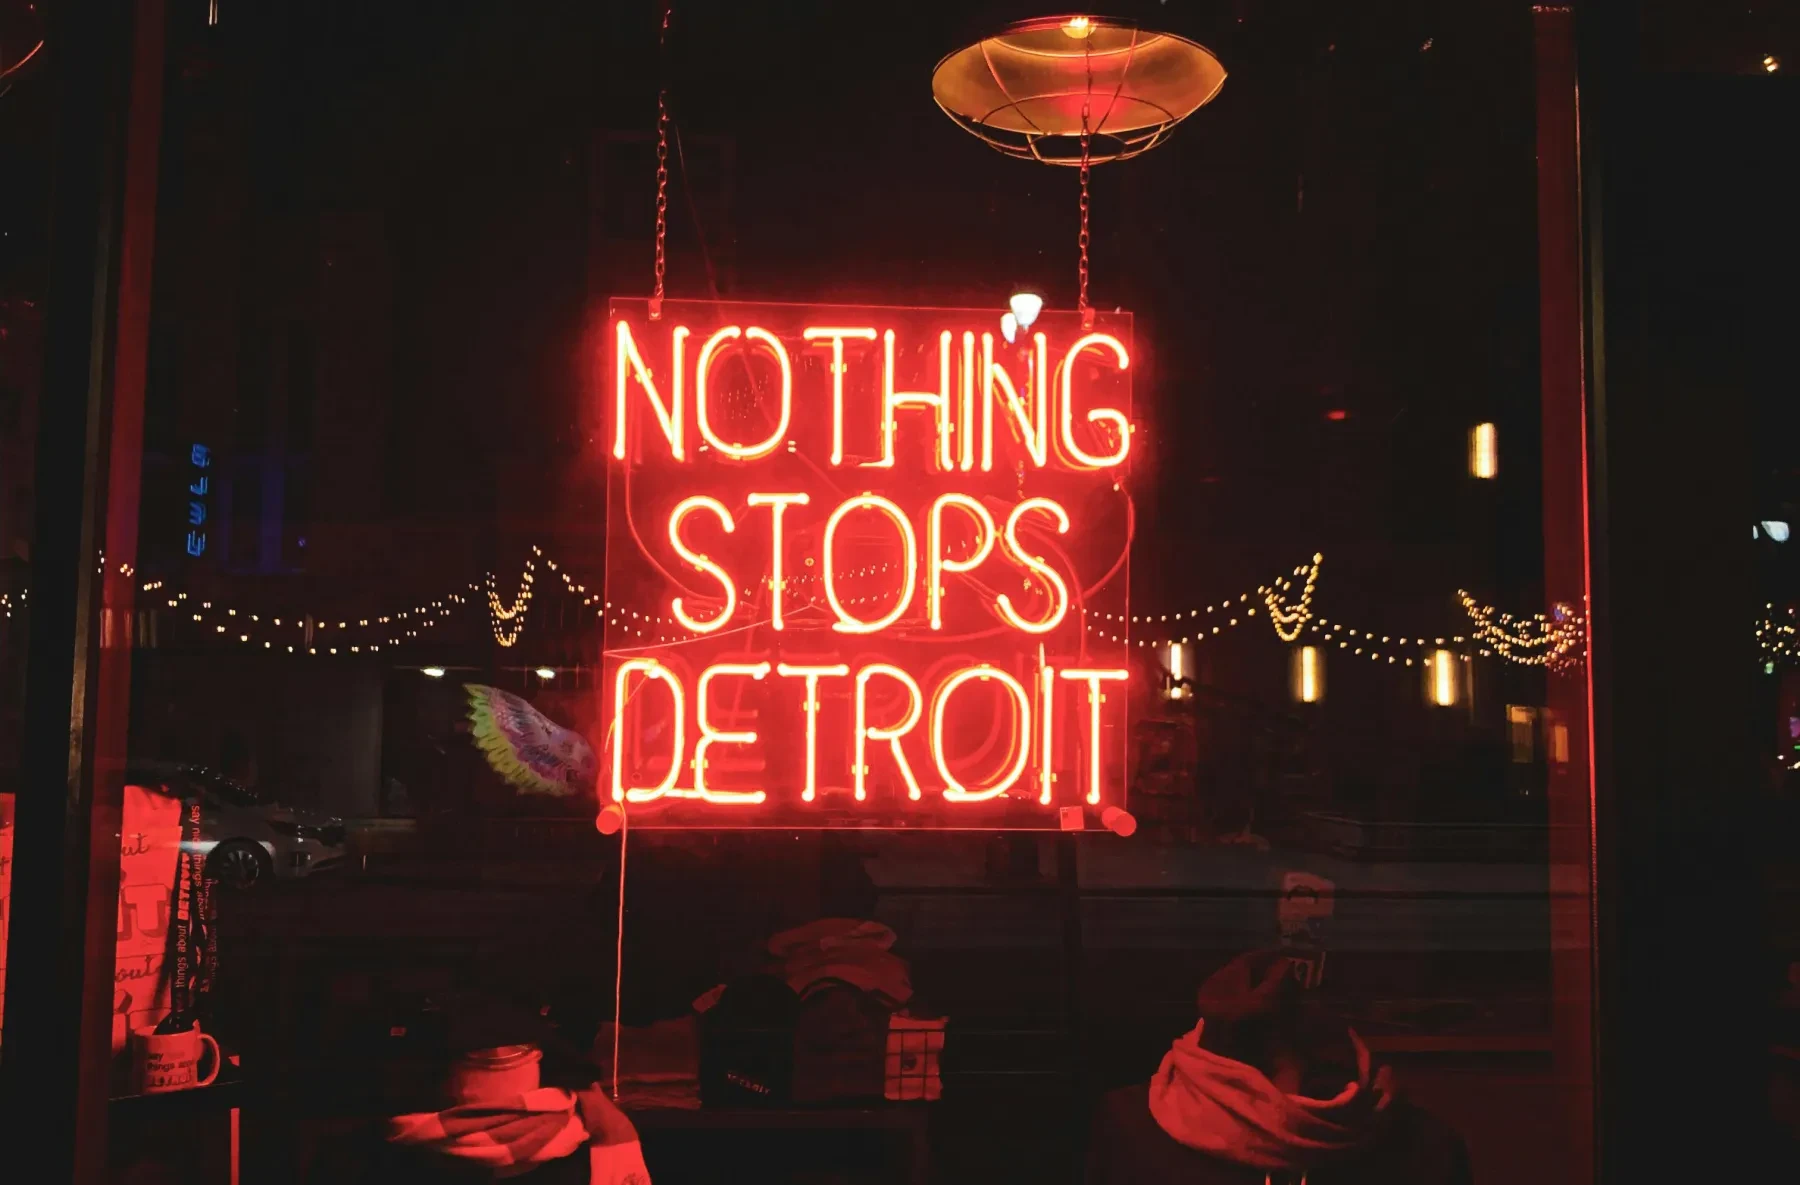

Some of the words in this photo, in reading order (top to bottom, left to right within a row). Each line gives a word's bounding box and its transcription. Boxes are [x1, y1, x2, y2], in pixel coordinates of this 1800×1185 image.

[613, 319, 1131, 471] NOTHING
[668, 491, 1070, 633] STOPS
[611, 660, 1129, 805] DETROIT
[175, 956, 189, 988] things
[177, 925, 188, 953] about
